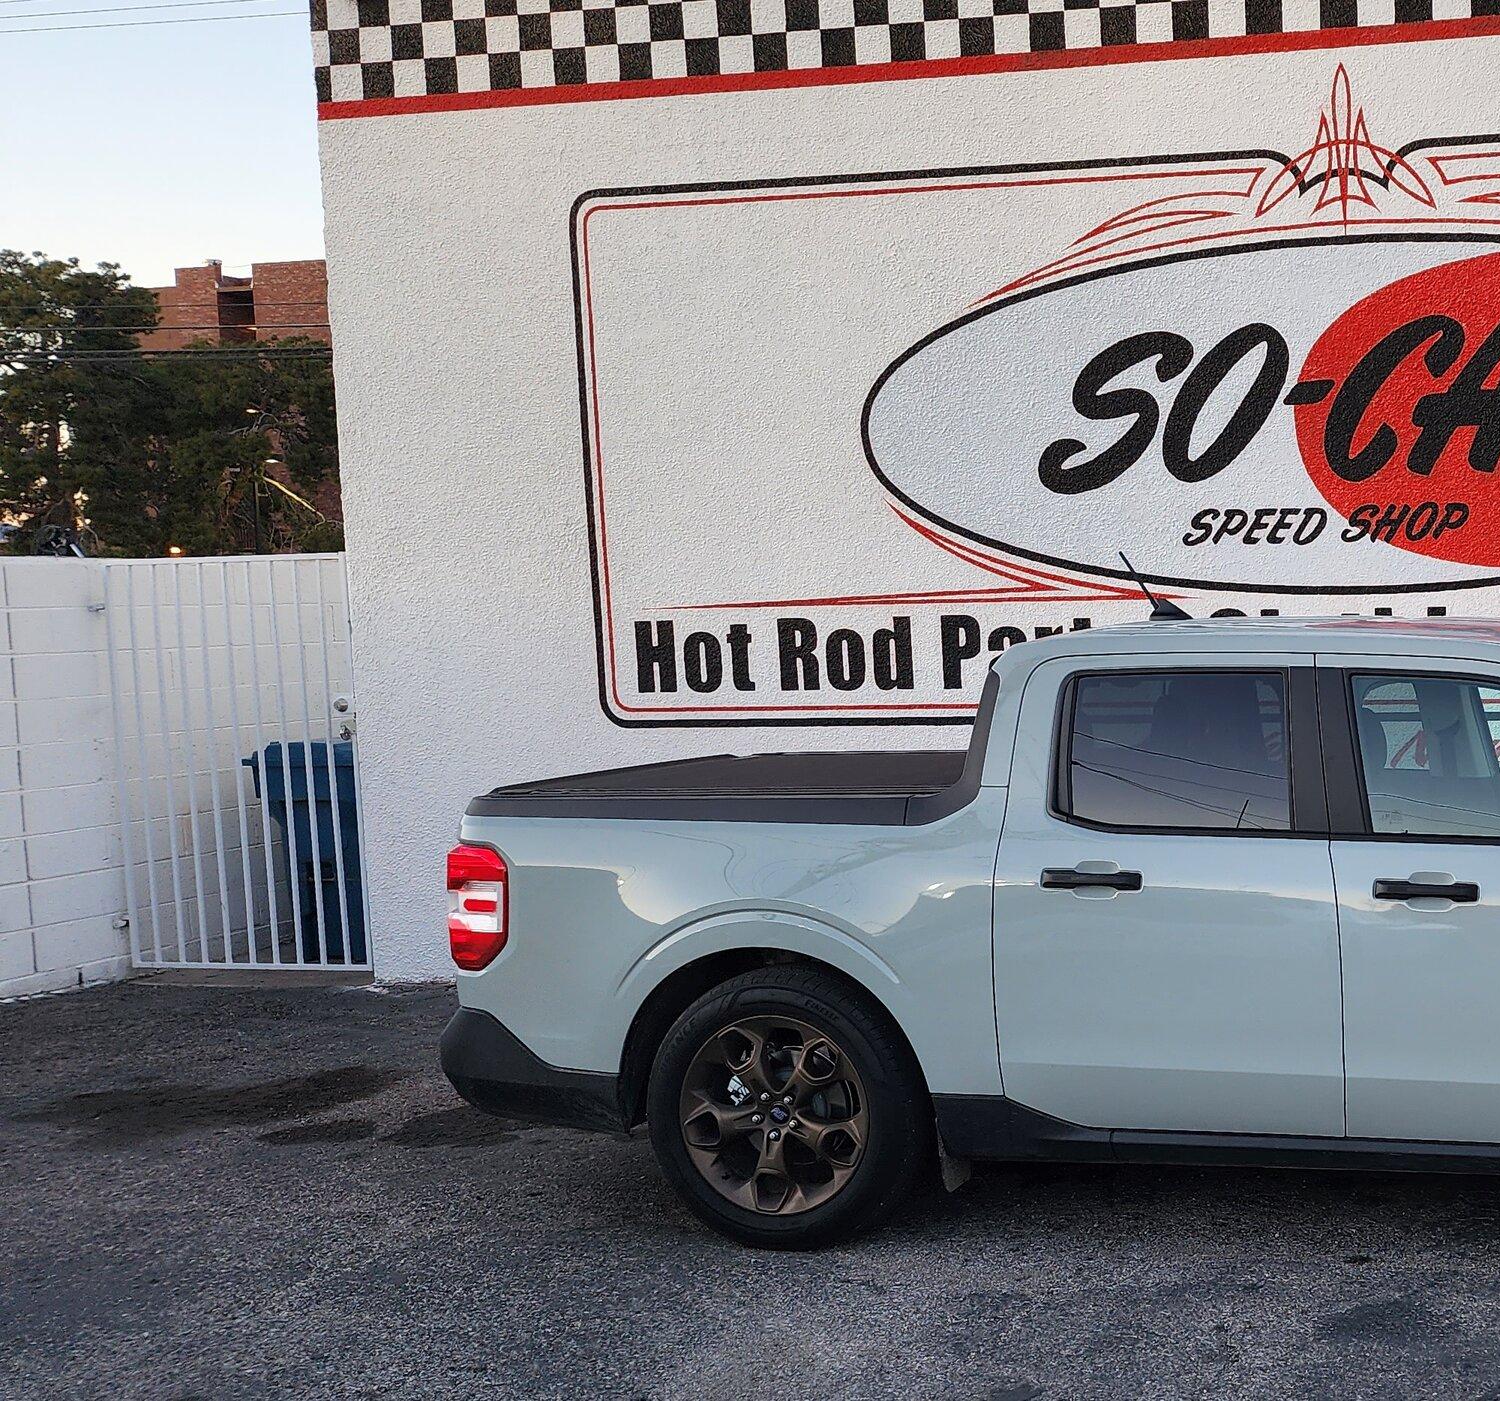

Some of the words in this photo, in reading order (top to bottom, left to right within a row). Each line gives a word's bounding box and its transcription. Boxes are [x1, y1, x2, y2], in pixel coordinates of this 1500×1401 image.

[1183, 508, 1327, 546] SPEED
[1341, 502, 1469, 543] SHOP
[635, 620, 755, 693] Hot
[777, 617, 914, 691] Rod
